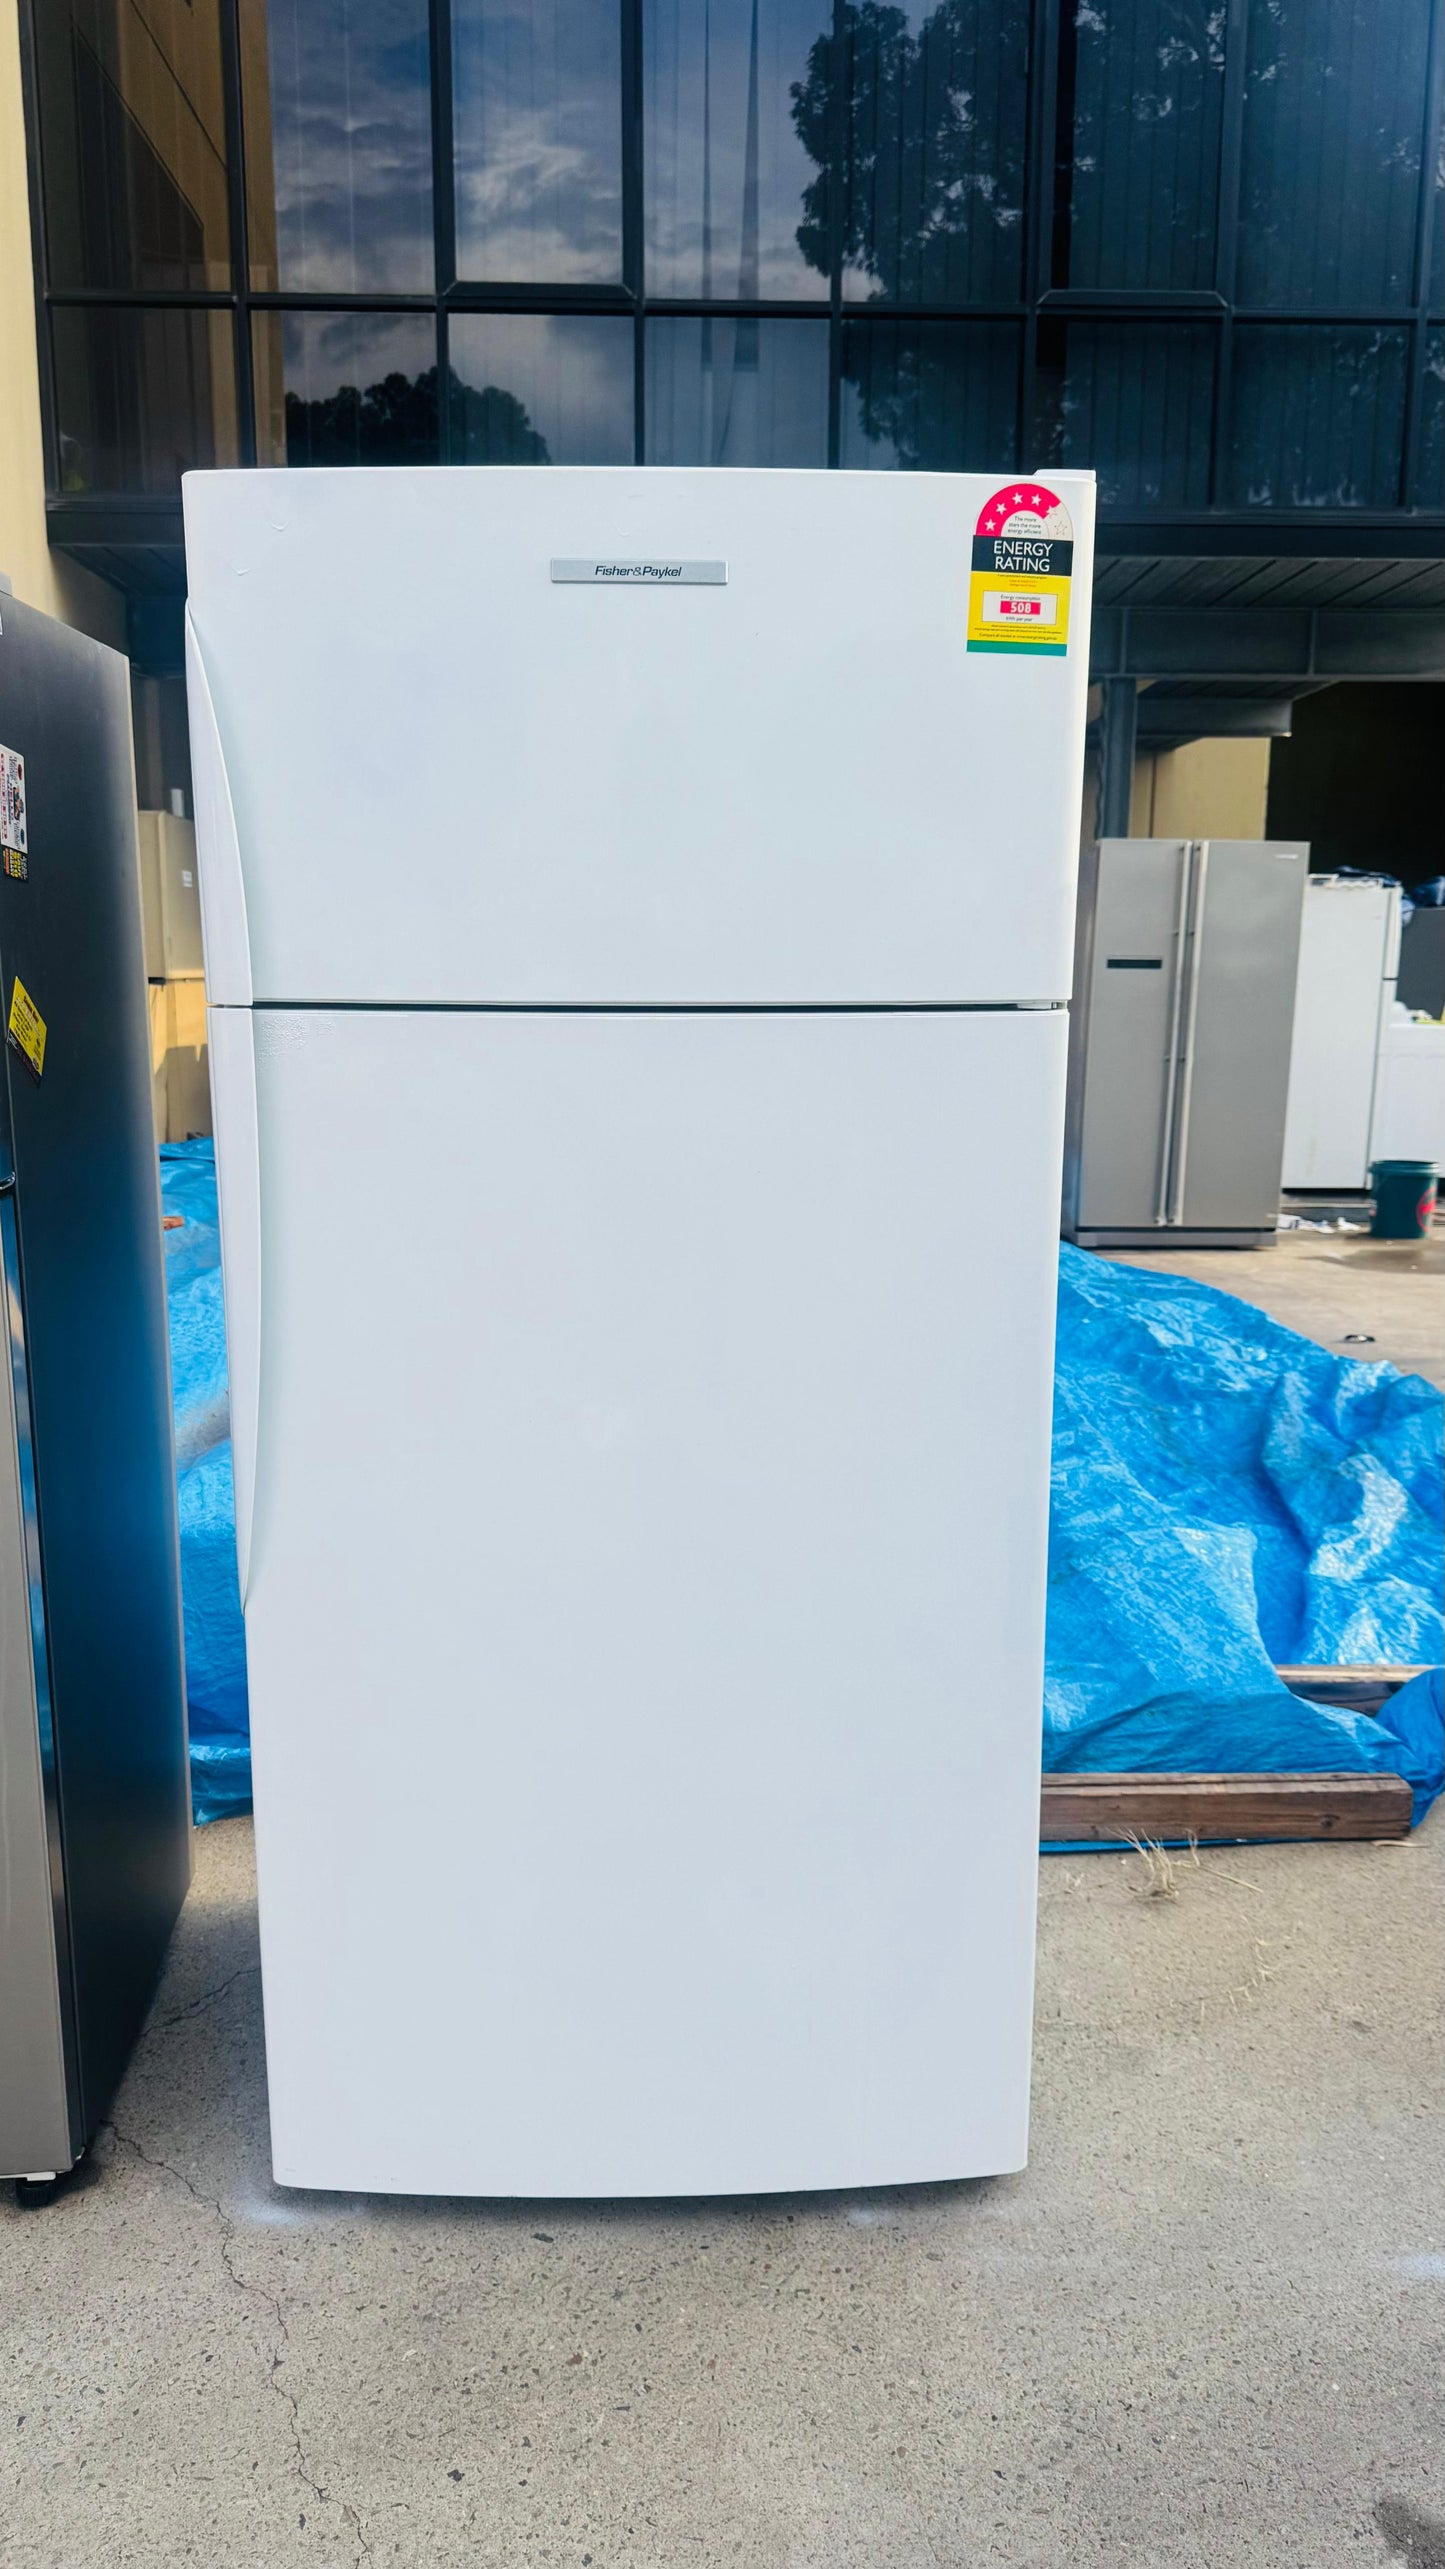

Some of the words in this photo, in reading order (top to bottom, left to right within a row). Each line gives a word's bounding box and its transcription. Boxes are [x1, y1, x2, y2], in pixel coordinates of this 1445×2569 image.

[994, 540, 1053, 556] ENERGY
[995, 556, 1050, 572] RATING
[595, 565, 682, 579] Fisher&Paykel
[1010, 602, 1032, 613] 508
